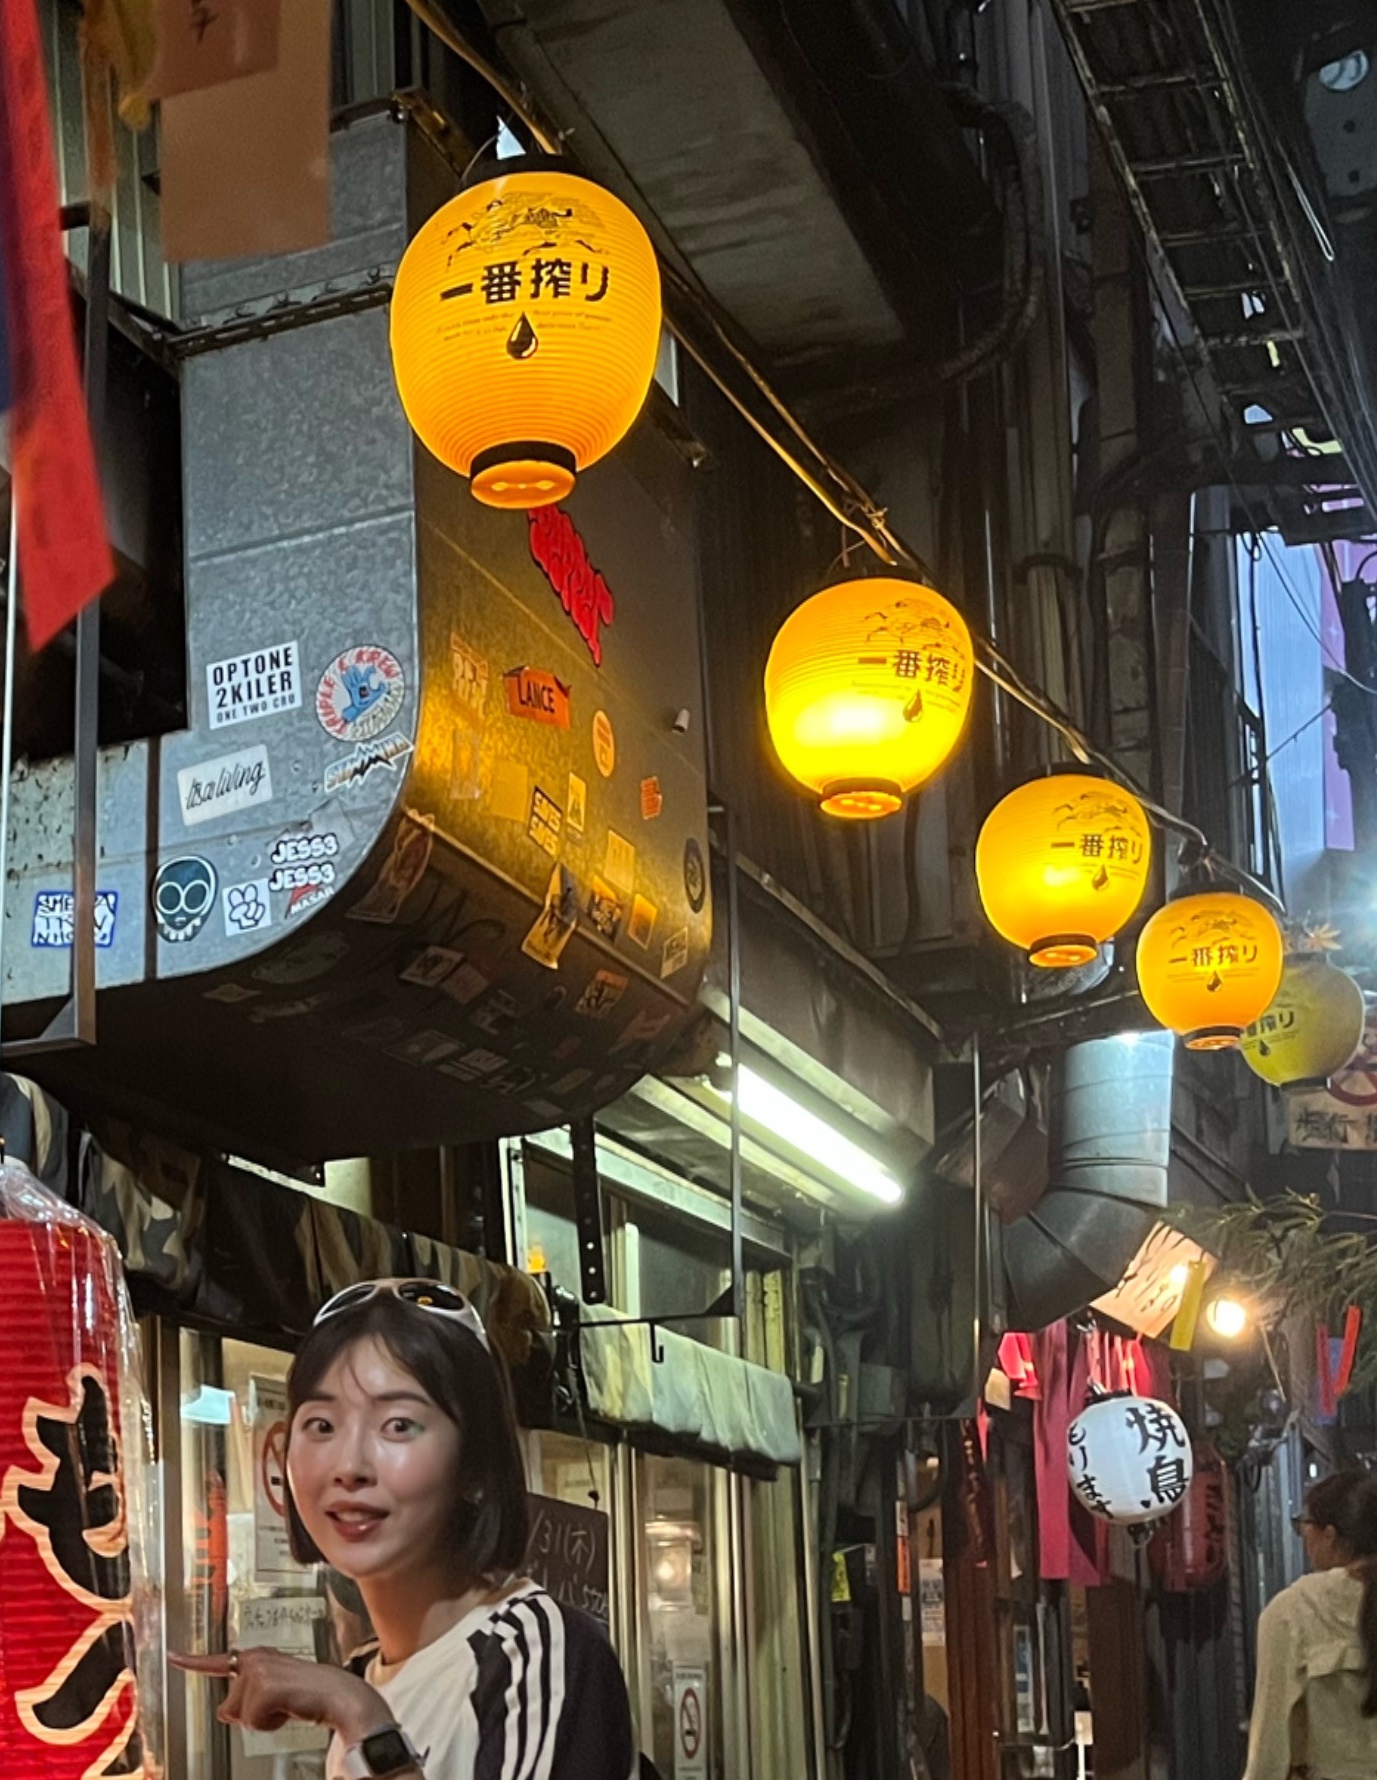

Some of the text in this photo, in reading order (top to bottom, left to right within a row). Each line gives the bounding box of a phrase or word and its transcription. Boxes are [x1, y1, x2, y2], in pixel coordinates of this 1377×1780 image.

[439, 256, 610, 305] 一番搾り
[212, 646, 293, 686] OPTONE
[857, 648, 966, 694] 一番搾り
[216, 670, 293, 709] 2KILER
[516, 675, 556, 714] LANCE
[217, 693, 296, 724] ONE TWO CRU
[271, 833, 338, 864] JESS3
[1051, 832, 1143, 866] 一番搾り
[268, 863, 336, 892] JESS3
[1168, 943, 1259, 968] 一番搾り
[1246, 1010, 1295, 1037] 番搾り
[1125, 1403, 1189, 1505] 焼鳥
